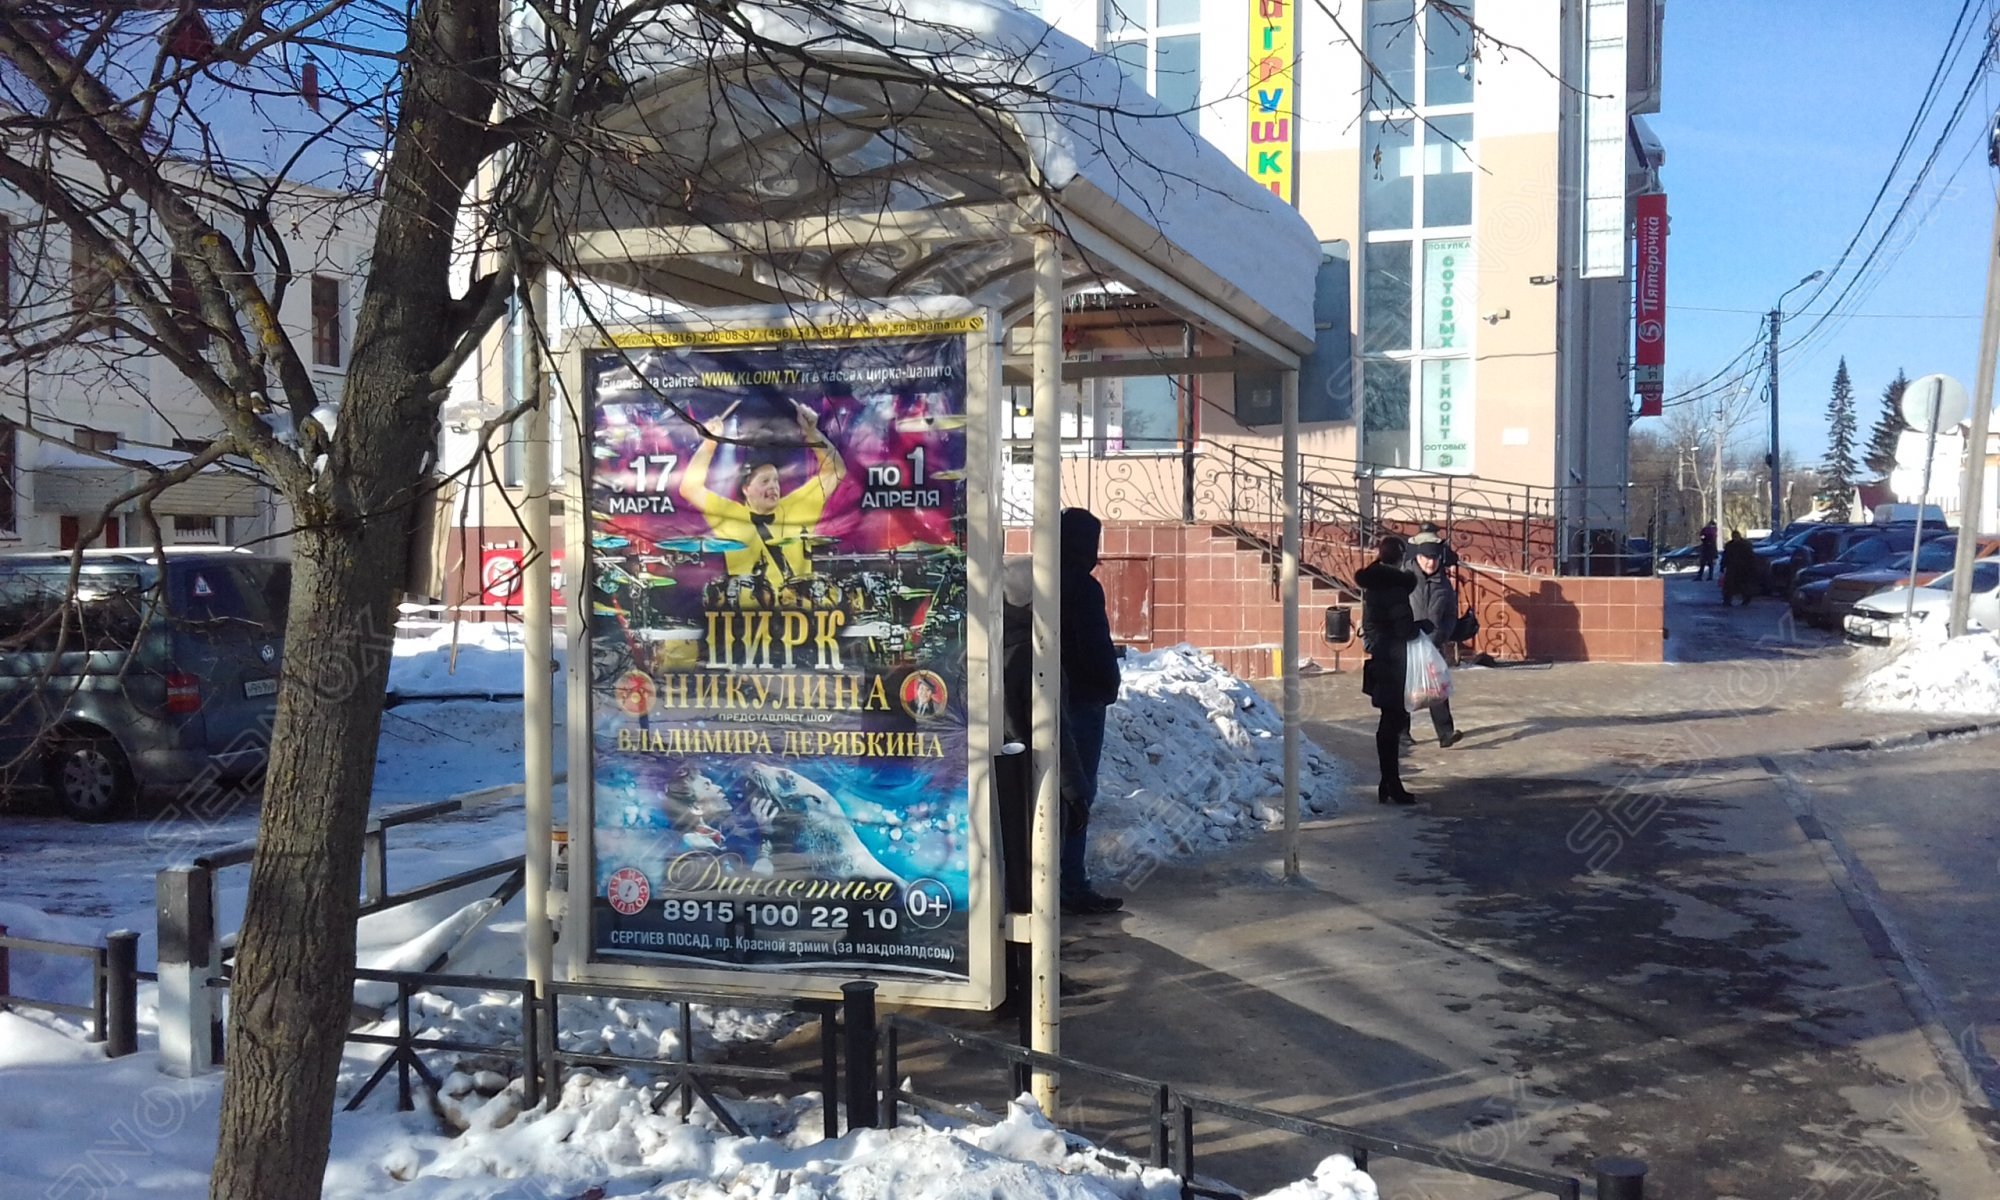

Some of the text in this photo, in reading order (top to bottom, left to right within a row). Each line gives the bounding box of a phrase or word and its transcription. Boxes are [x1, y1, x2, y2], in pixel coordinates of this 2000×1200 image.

[1642, 216, 1663, 315] Пятерочка
[661, 333, 697, 344] 8(916)
[764, 327, 794, 340] (496)
[662, 373, 698, 388] сайте:
[702, 369, 798, 386] WWW.KLOUN.TV
[801, 372, 809, 383] и
[812, 372, 820, 382] в
[823, 370, 863, 382] кассах
[866, 365, 952, 383] цирка-шапито
[1440, 360, 1451, 439] РЕМОНТ
[629, 454, 677, 492] 17
[906, 446, 924, 485] 1
[609, 496, 675, 514] МАРТА
[861, 490, 940, 508] АПРЕЛЯ
[703, 610, 846, 671] ЦИРК
[663, 672, 892, 711] НИКУЛИНА
[718, 713, 833, 723] ПРЕДСТАВЛЯЕТ ШОУ
[617, 728, 944, 758] ВЛАДИМИРА ДЕРЯБКИНА
[666, 850, 896, 902] Династия
[663, 899, 898, 930] 8915 100 22 10
[908, 889, 948, 918] 0+
[611, 930, 665, 946] СЕРГИЕВ
[715, 936, 733, 951] пр.
[735, 935, 787, 953] Красной
[788, 940, 829, 956] армии
[832, 938, 854, 956] (за
[856, 943, 955, 963] макдоналдсом)
